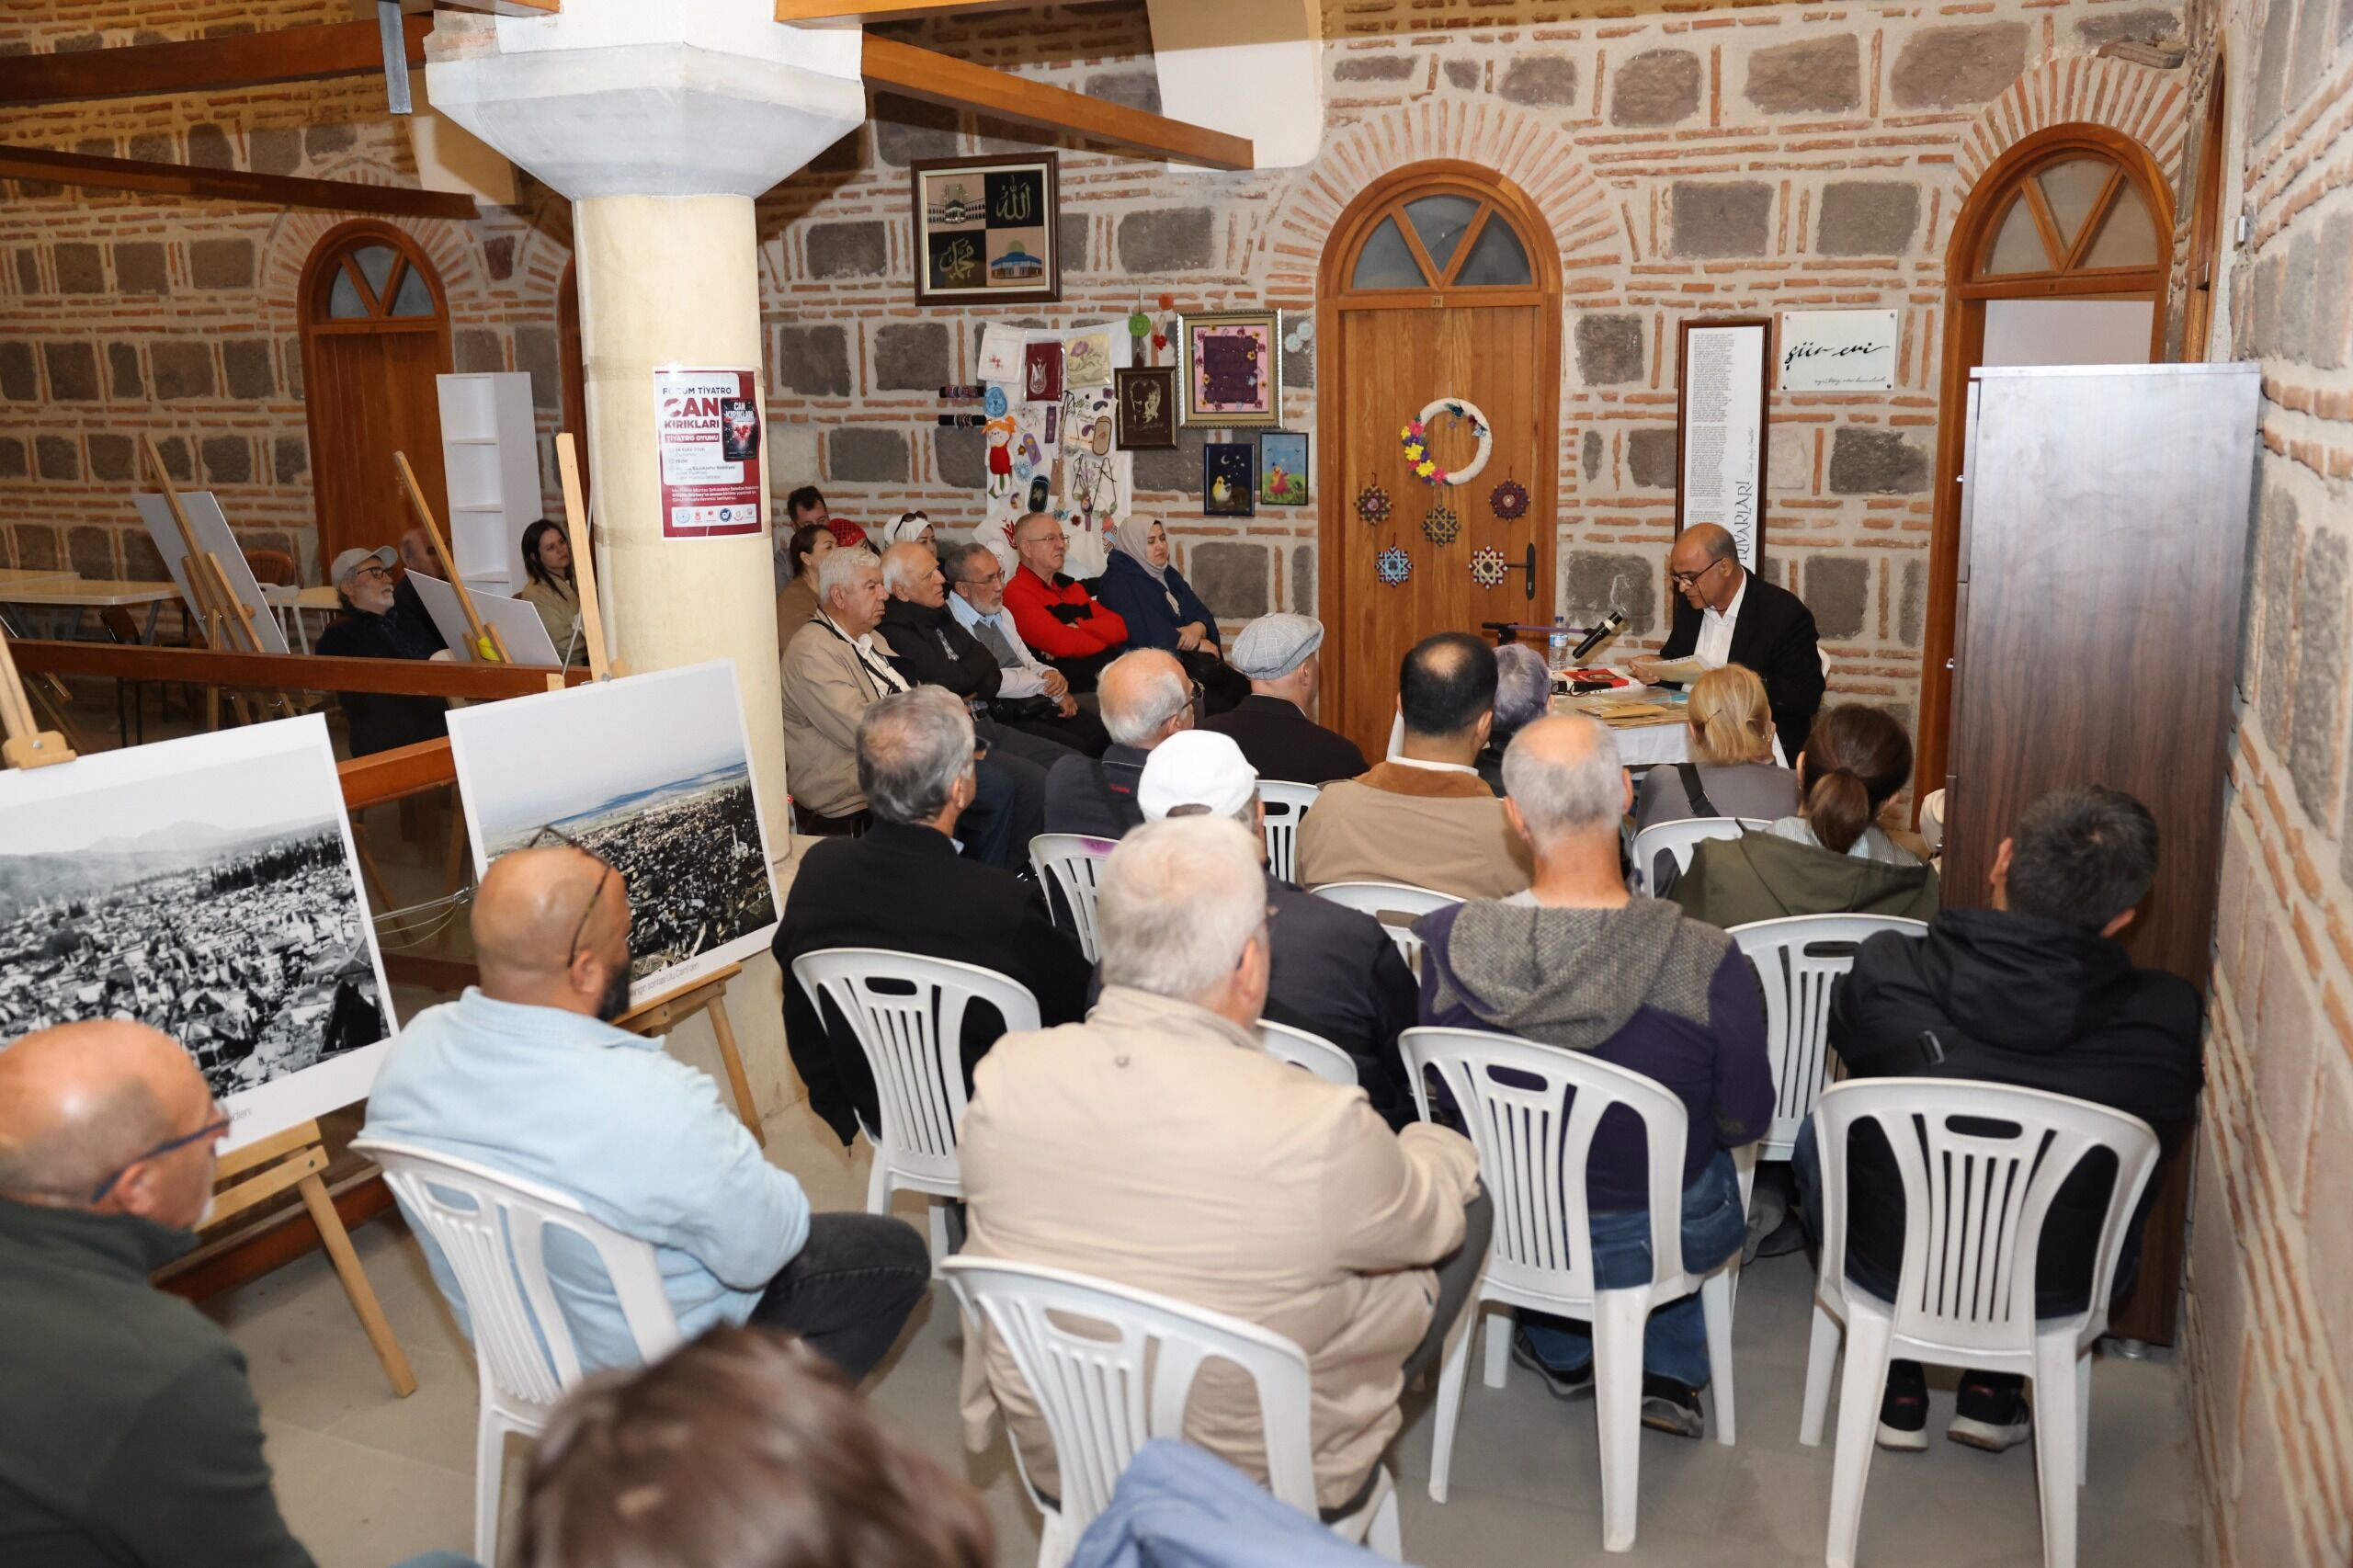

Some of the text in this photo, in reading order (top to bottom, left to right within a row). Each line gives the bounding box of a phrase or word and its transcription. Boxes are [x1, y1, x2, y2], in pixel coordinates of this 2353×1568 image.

[663, 386, 732, 395] FUM TİYATRO
[664, 397, 720, 417] CAN
[665, 419, 720, 429] KIRIKLARI
[666, 434, 695, 442] TİYATRO
